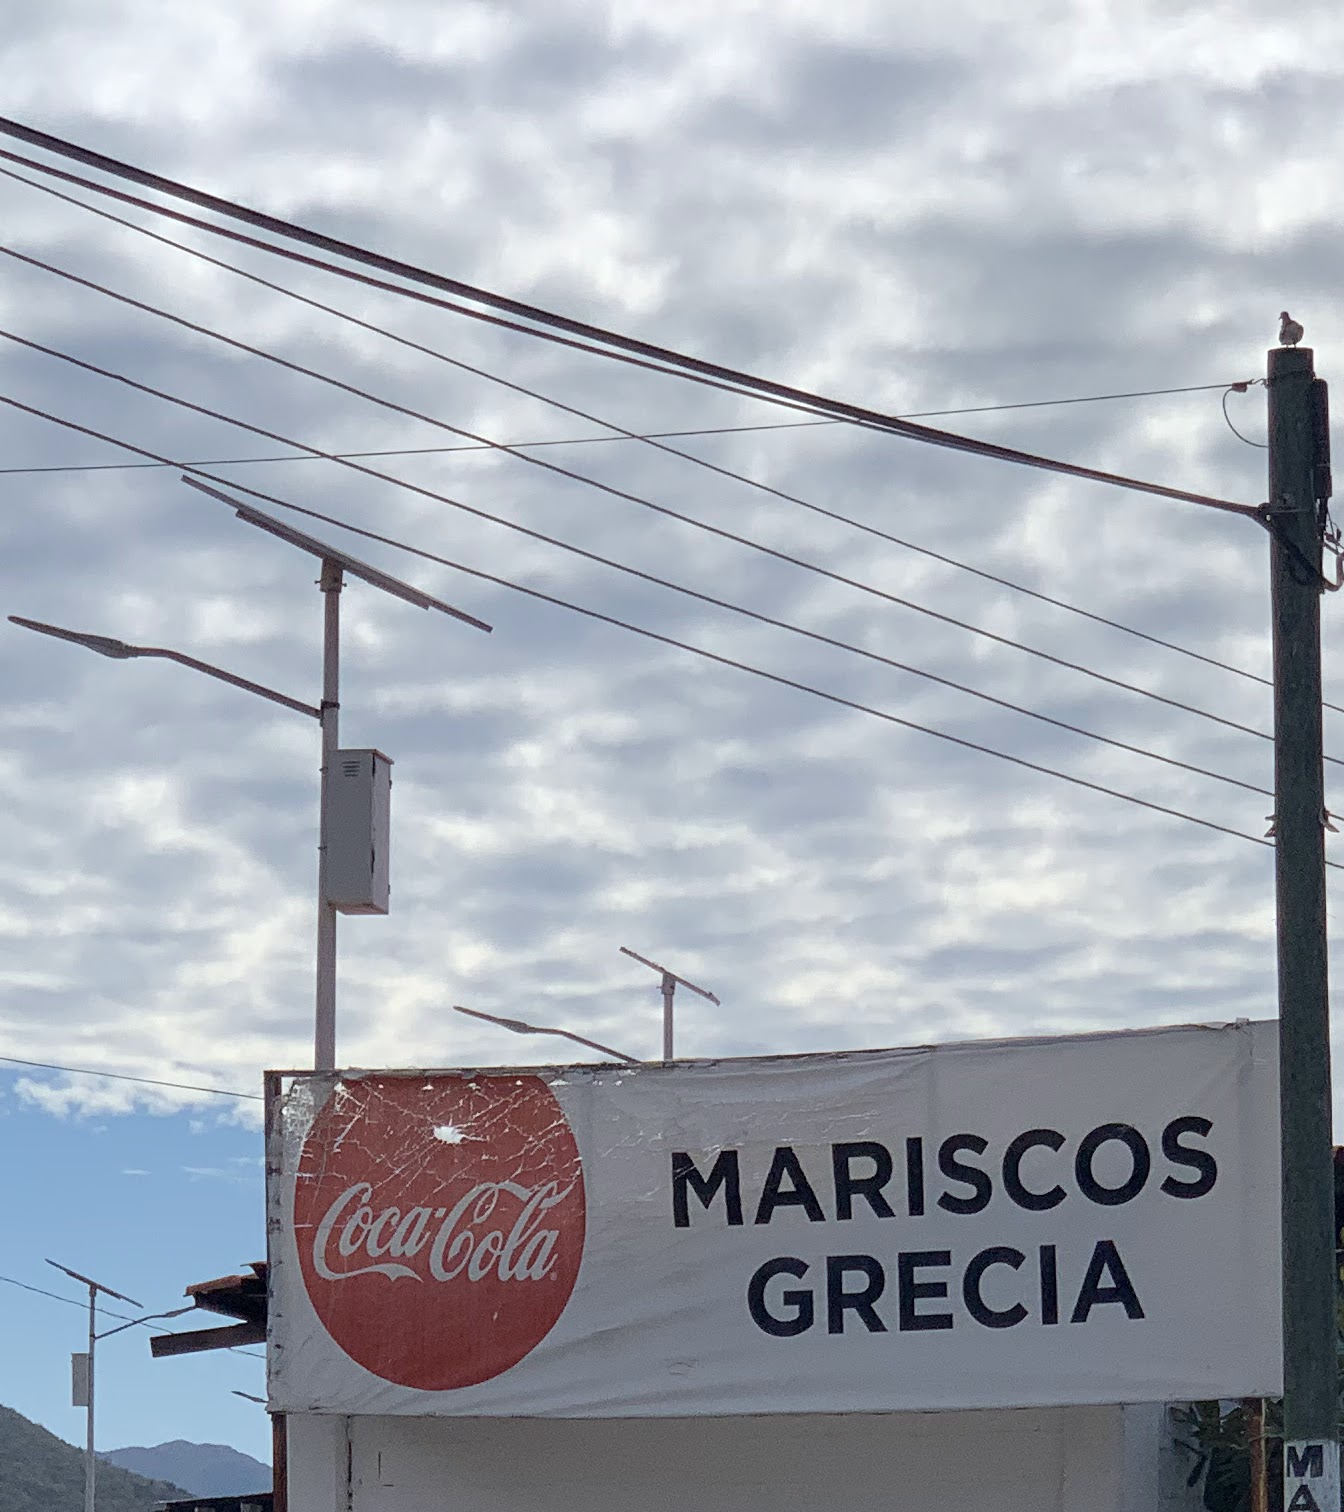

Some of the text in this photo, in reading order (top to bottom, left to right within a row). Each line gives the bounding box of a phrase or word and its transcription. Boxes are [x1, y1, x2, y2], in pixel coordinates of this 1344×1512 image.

[670, 1115, 1219, 1228] MARISCOS
[312, 1180, 580, 1283] Coca-Cola
[747, 1239, 1146, 1338] GRECIA
